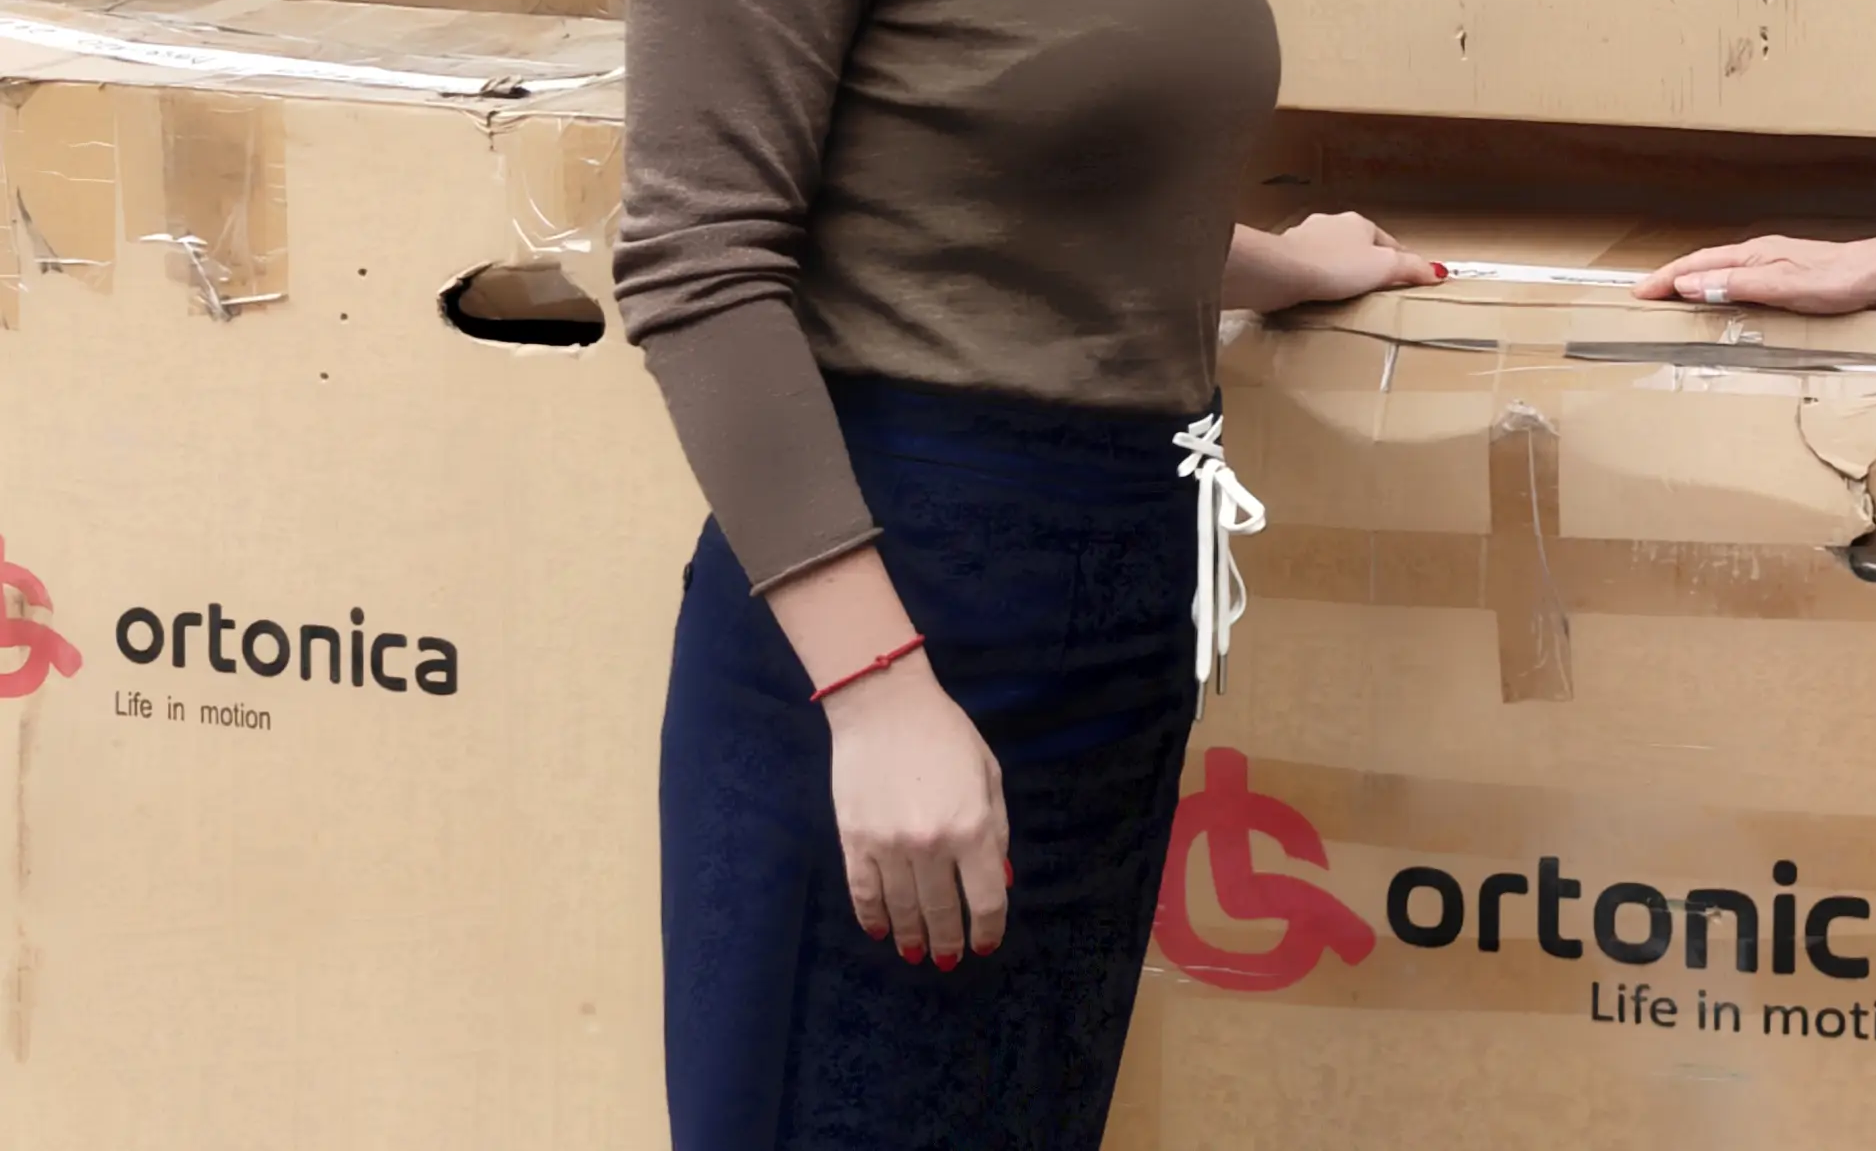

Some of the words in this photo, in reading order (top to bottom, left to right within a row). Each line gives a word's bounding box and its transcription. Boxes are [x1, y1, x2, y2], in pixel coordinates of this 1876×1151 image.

[115, 602, 458, 696] ortonica
[115, 690, 153, 719] Life
[167, 695, 185, 722] in
[200, 701, 272, 730] motion
[1591, 981, 1679, 1029] Life
[1698, 990, 1742, 1034] in
